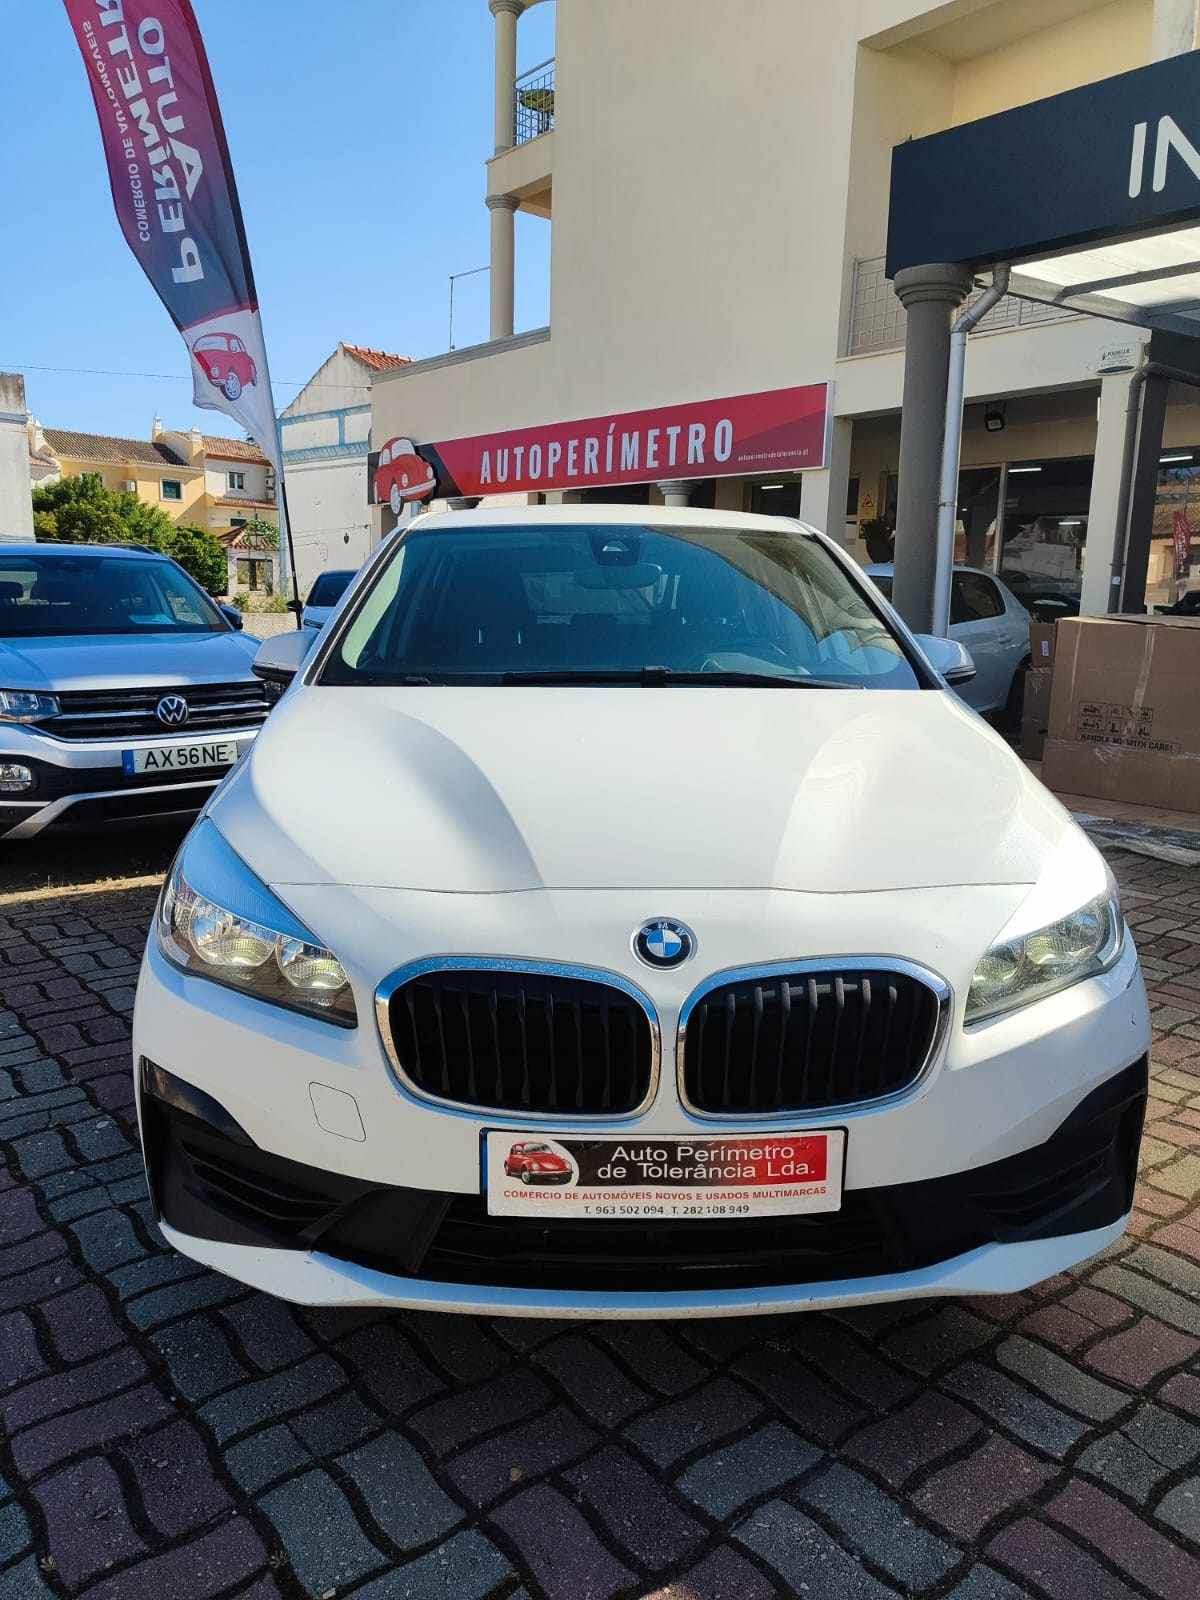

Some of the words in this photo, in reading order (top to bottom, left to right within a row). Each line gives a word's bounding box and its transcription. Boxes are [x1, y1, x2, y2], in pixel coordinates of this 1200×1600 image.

[480, 419, 733, 484] AUTOPERÍMETRO
[611, 1145, 668, 1161] Auto
[677, 1144, 794, 1162] Perímetro
[597, 1163, 628, 1179] de
[637, 1162, 757, 1179] Tolerância
[767, 1160, 815, 1177] Lda.
[565, 1191, 579, 1200] DE
[582, 1189, 652, 1201] AUTOMÓVEIS
[655, 1192, 693, 1201] NOVOS
[696, 1192, 701, 1200] E
[706, 1191, 750, 1200] USADOS
[752, 1186, 827, 1199] MULTIMARCAS
[595, 1205, 616, 1215] 963
[619, 1205, 640, 1215] 502
[643, 1205, 665, 1215] 094
[683, 1206, 703, 1215] 282
[729, 1204, 750, 1214] 949
